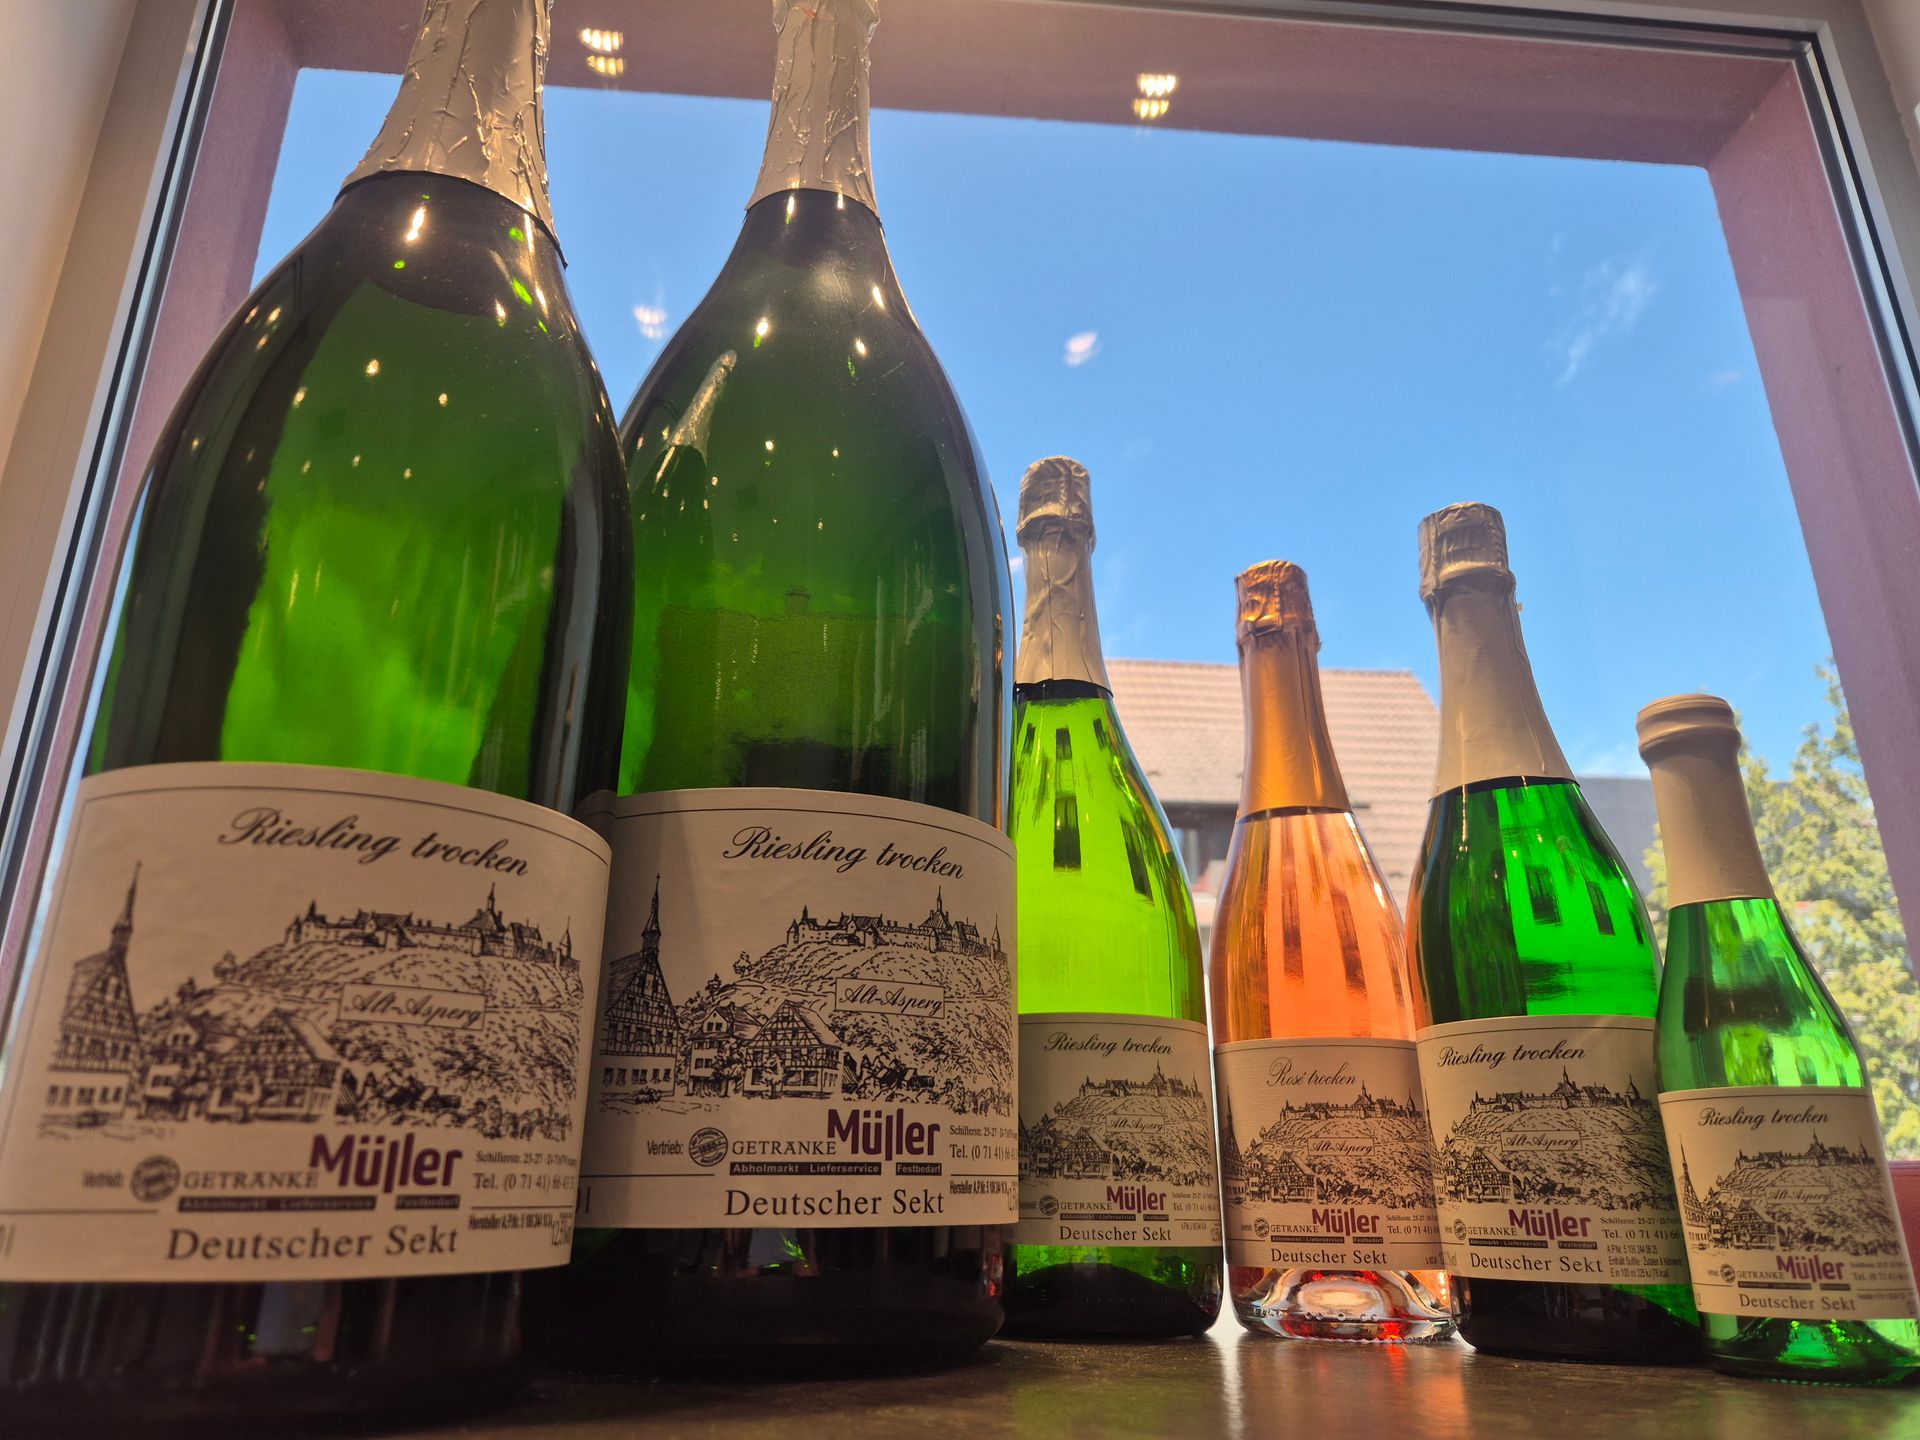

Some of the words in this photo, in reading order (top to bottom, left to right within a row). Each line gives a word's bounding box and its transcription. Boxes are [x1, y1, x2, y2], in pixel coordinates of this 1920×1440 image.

[217, 807, 402, 864] Riesling
[411, 832, 528, 876] trocken
[722, 826, 868, 874] Riesling
[876, 842, 965, 880] trocken
[345, 991, 482, 1026] Alt-Asperg
[840, 984, 944, 1016] Alt-Asperg
[1044, 1032, 1118, 1057] Riesling
[1123, 1036, 1172, 1055] trocken
[1437, 1044, 1506, 1069] Riesling
[1513, 1039, 1585, 1061] trocken
[1266, 1056, 1306, 1087] Rosé
[1308, 1061, 1358, 1085] trocken
[1108, 1117, 1164, 1132] Alt-Asperg
[1698, 1107, 1766, 1131] Riesling
[1771, 1104, 1829, 1124] trocken
[647, 1140, 684, 1155] Vertrieb:
[827, 1108, 941, 1161] Müller
[1311, 1140, 1373, 1155] Alt-Asperg
[1503, 1134, 1579, 1151] Alt-Asperg
[309, 1133, 463, 1193] Müller
[949, 1143, 968, 1158] Tel.
[971, 1145, 981, 1161] (0
[983, 1145, 992, 1159] 71
[473, 1172, 498, 1190] Tel.
[503, 1173, 517, 1191] (0
[732, 1163, 800, 1173] Abholmarkt
[809, 1163, 880, 1173] Lieferservice
[896, 1163, 941, 1174] Festbedarf
[724, 1189, 882, 1216] Deutscher
[893, 1189, 944, 1214] Sekt
[1107, 1185, 1167, 1213] Müller
[1060, 1226, 1137, 1241] Deutscher
[1143, 1227, 1172, 1241] Sekt
[1312, 1208, 1380, 1236] Müller
[1387, 1225, 1401, 1234] Tel.
[1403, 1225, 1412, 1235] (0
[1413, 1226, 1421, 1234] 71
[1508, 1208, 1591, 1240] Müller
[1602, 1229, 1621, 1239] Tel.
[1625, 1230, 1636, 1240] (0
[1639, 1230, 1650, 1239] 71
[1653, 1230, 1668, 1241] 41)
[166, 1226, 372, 1260] Deutscher
[386, 1224, 458, 1255] Sekt
[1271, 1248, 1347, 1264] Deutscher
[1353, 1250, 1387, 1264] Sekt
[1470, 1253, 1552, 1271] Deutscher
[1559, 1255, 1603, 1273] Sekt
[1776, 1255, 1845, 1283] Müller
[1739, 1293, 1815, 1310] Deutscher
[1821, 1296, 1857, 1311] Sekt
